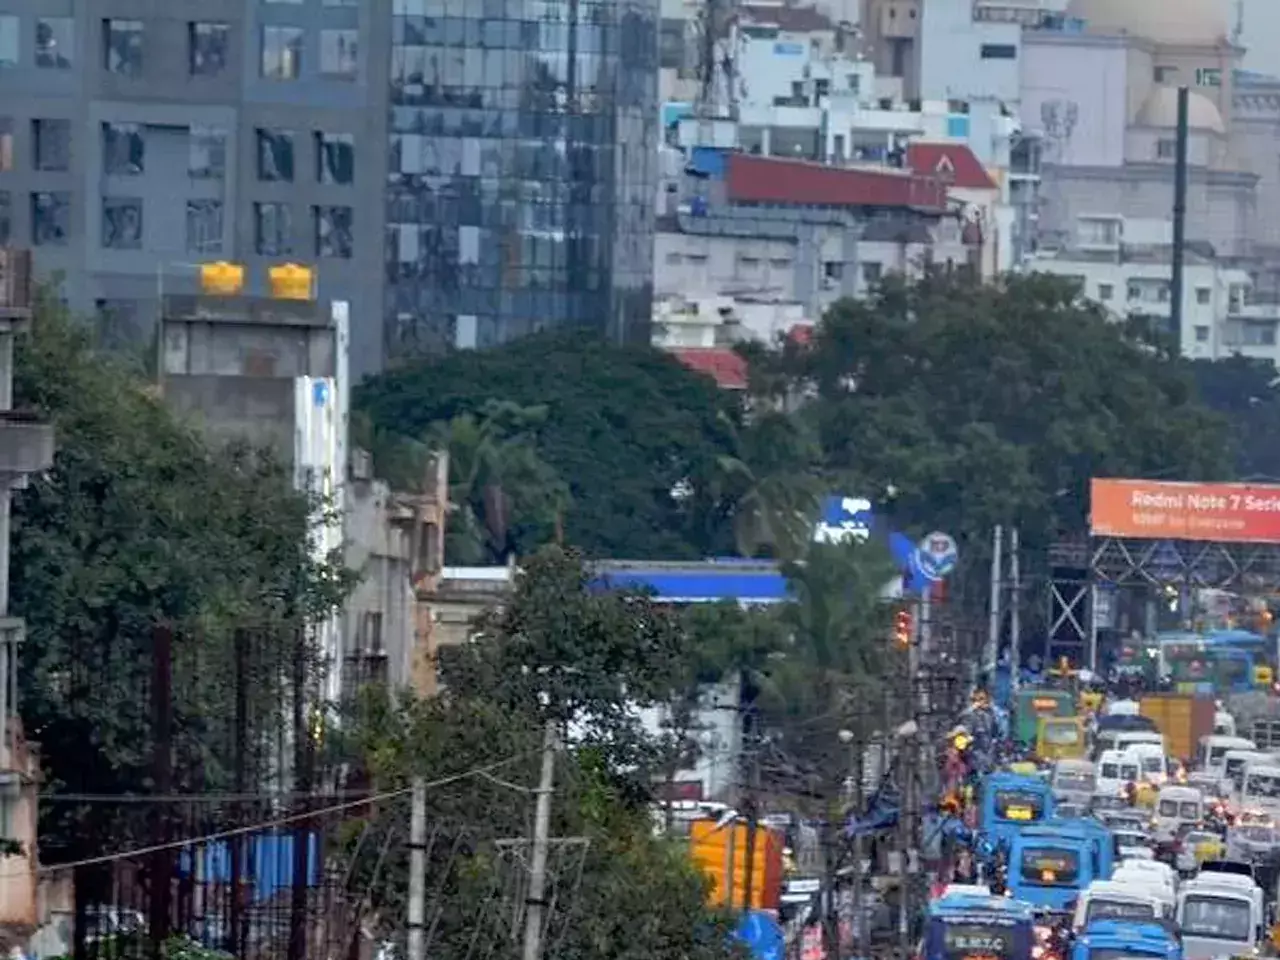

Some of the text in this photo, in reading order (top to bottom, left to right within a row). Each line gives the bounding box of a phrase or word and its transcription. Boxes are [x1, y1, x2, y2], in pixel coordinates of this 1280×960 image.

[1131, 490, 1183, 508] Redmi
[1187, 494, 1226, 509] Note
[1229, 494, 1241, 510] 7
